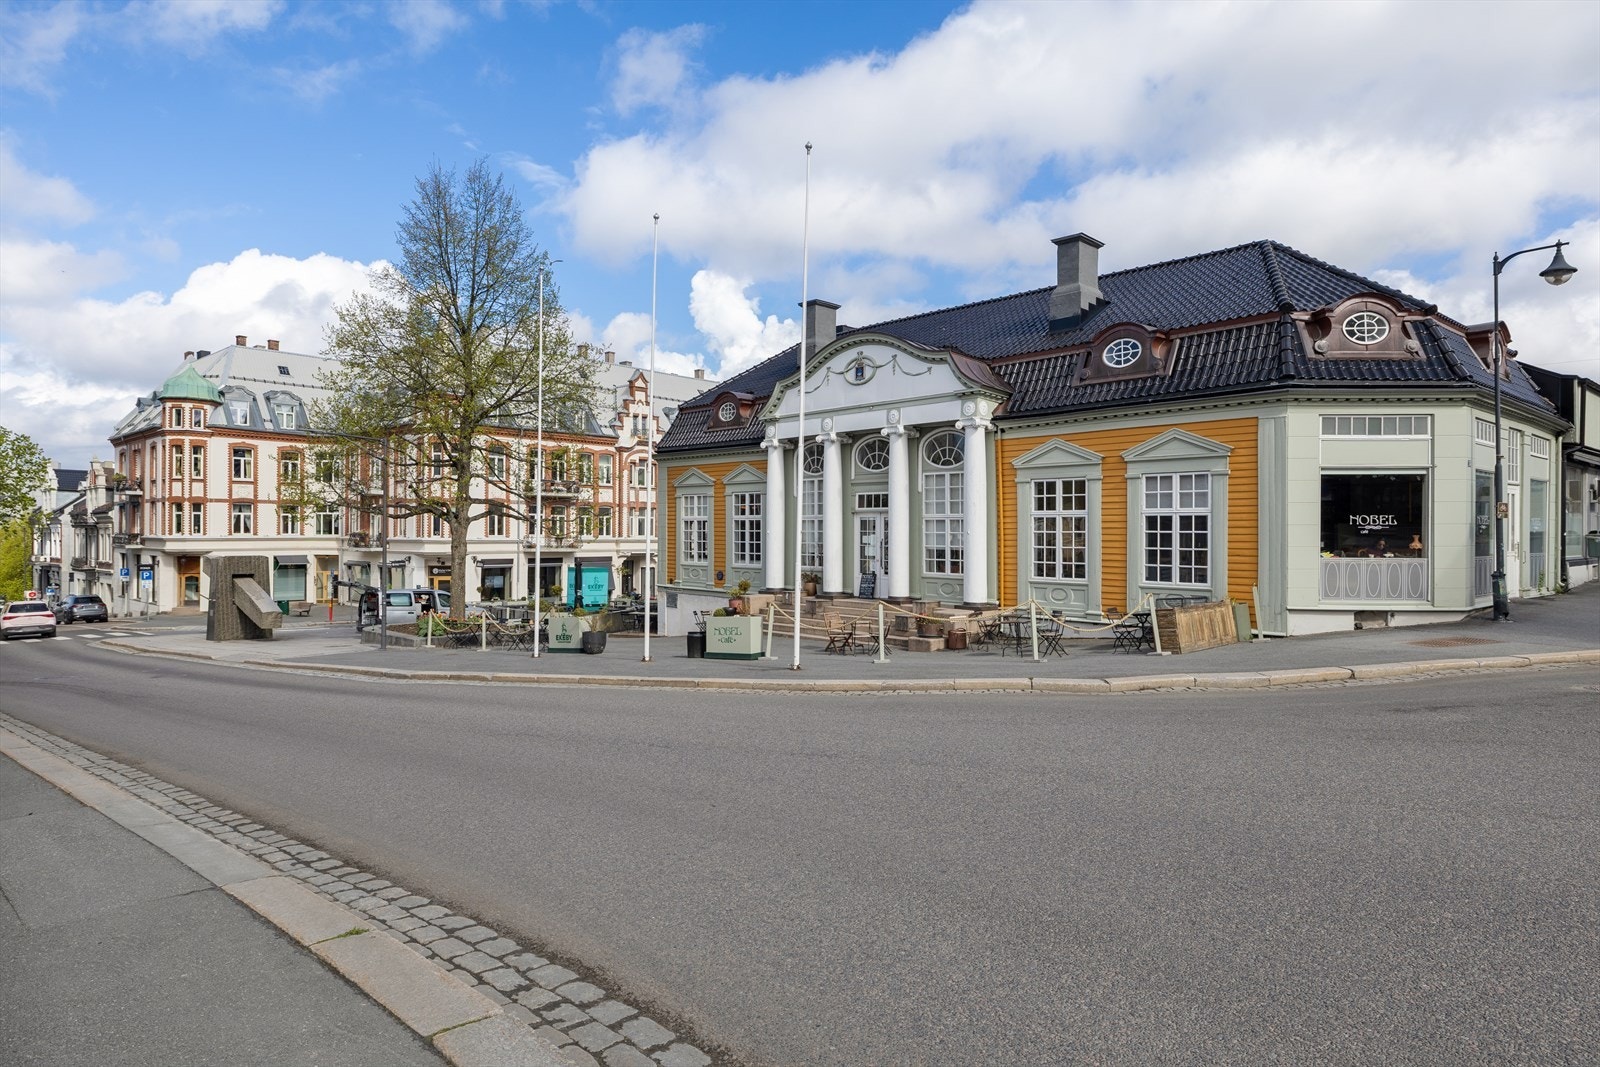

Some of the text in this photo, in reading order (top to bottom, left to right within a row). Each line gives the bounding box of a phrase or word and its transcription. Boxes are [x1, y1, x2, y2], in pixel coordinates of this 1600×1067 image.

[1349, 514, 1398, 526] NOBEL
[713, 626, 743, 636] NOBEL
[555, 633, 573, 641] EKEBY
